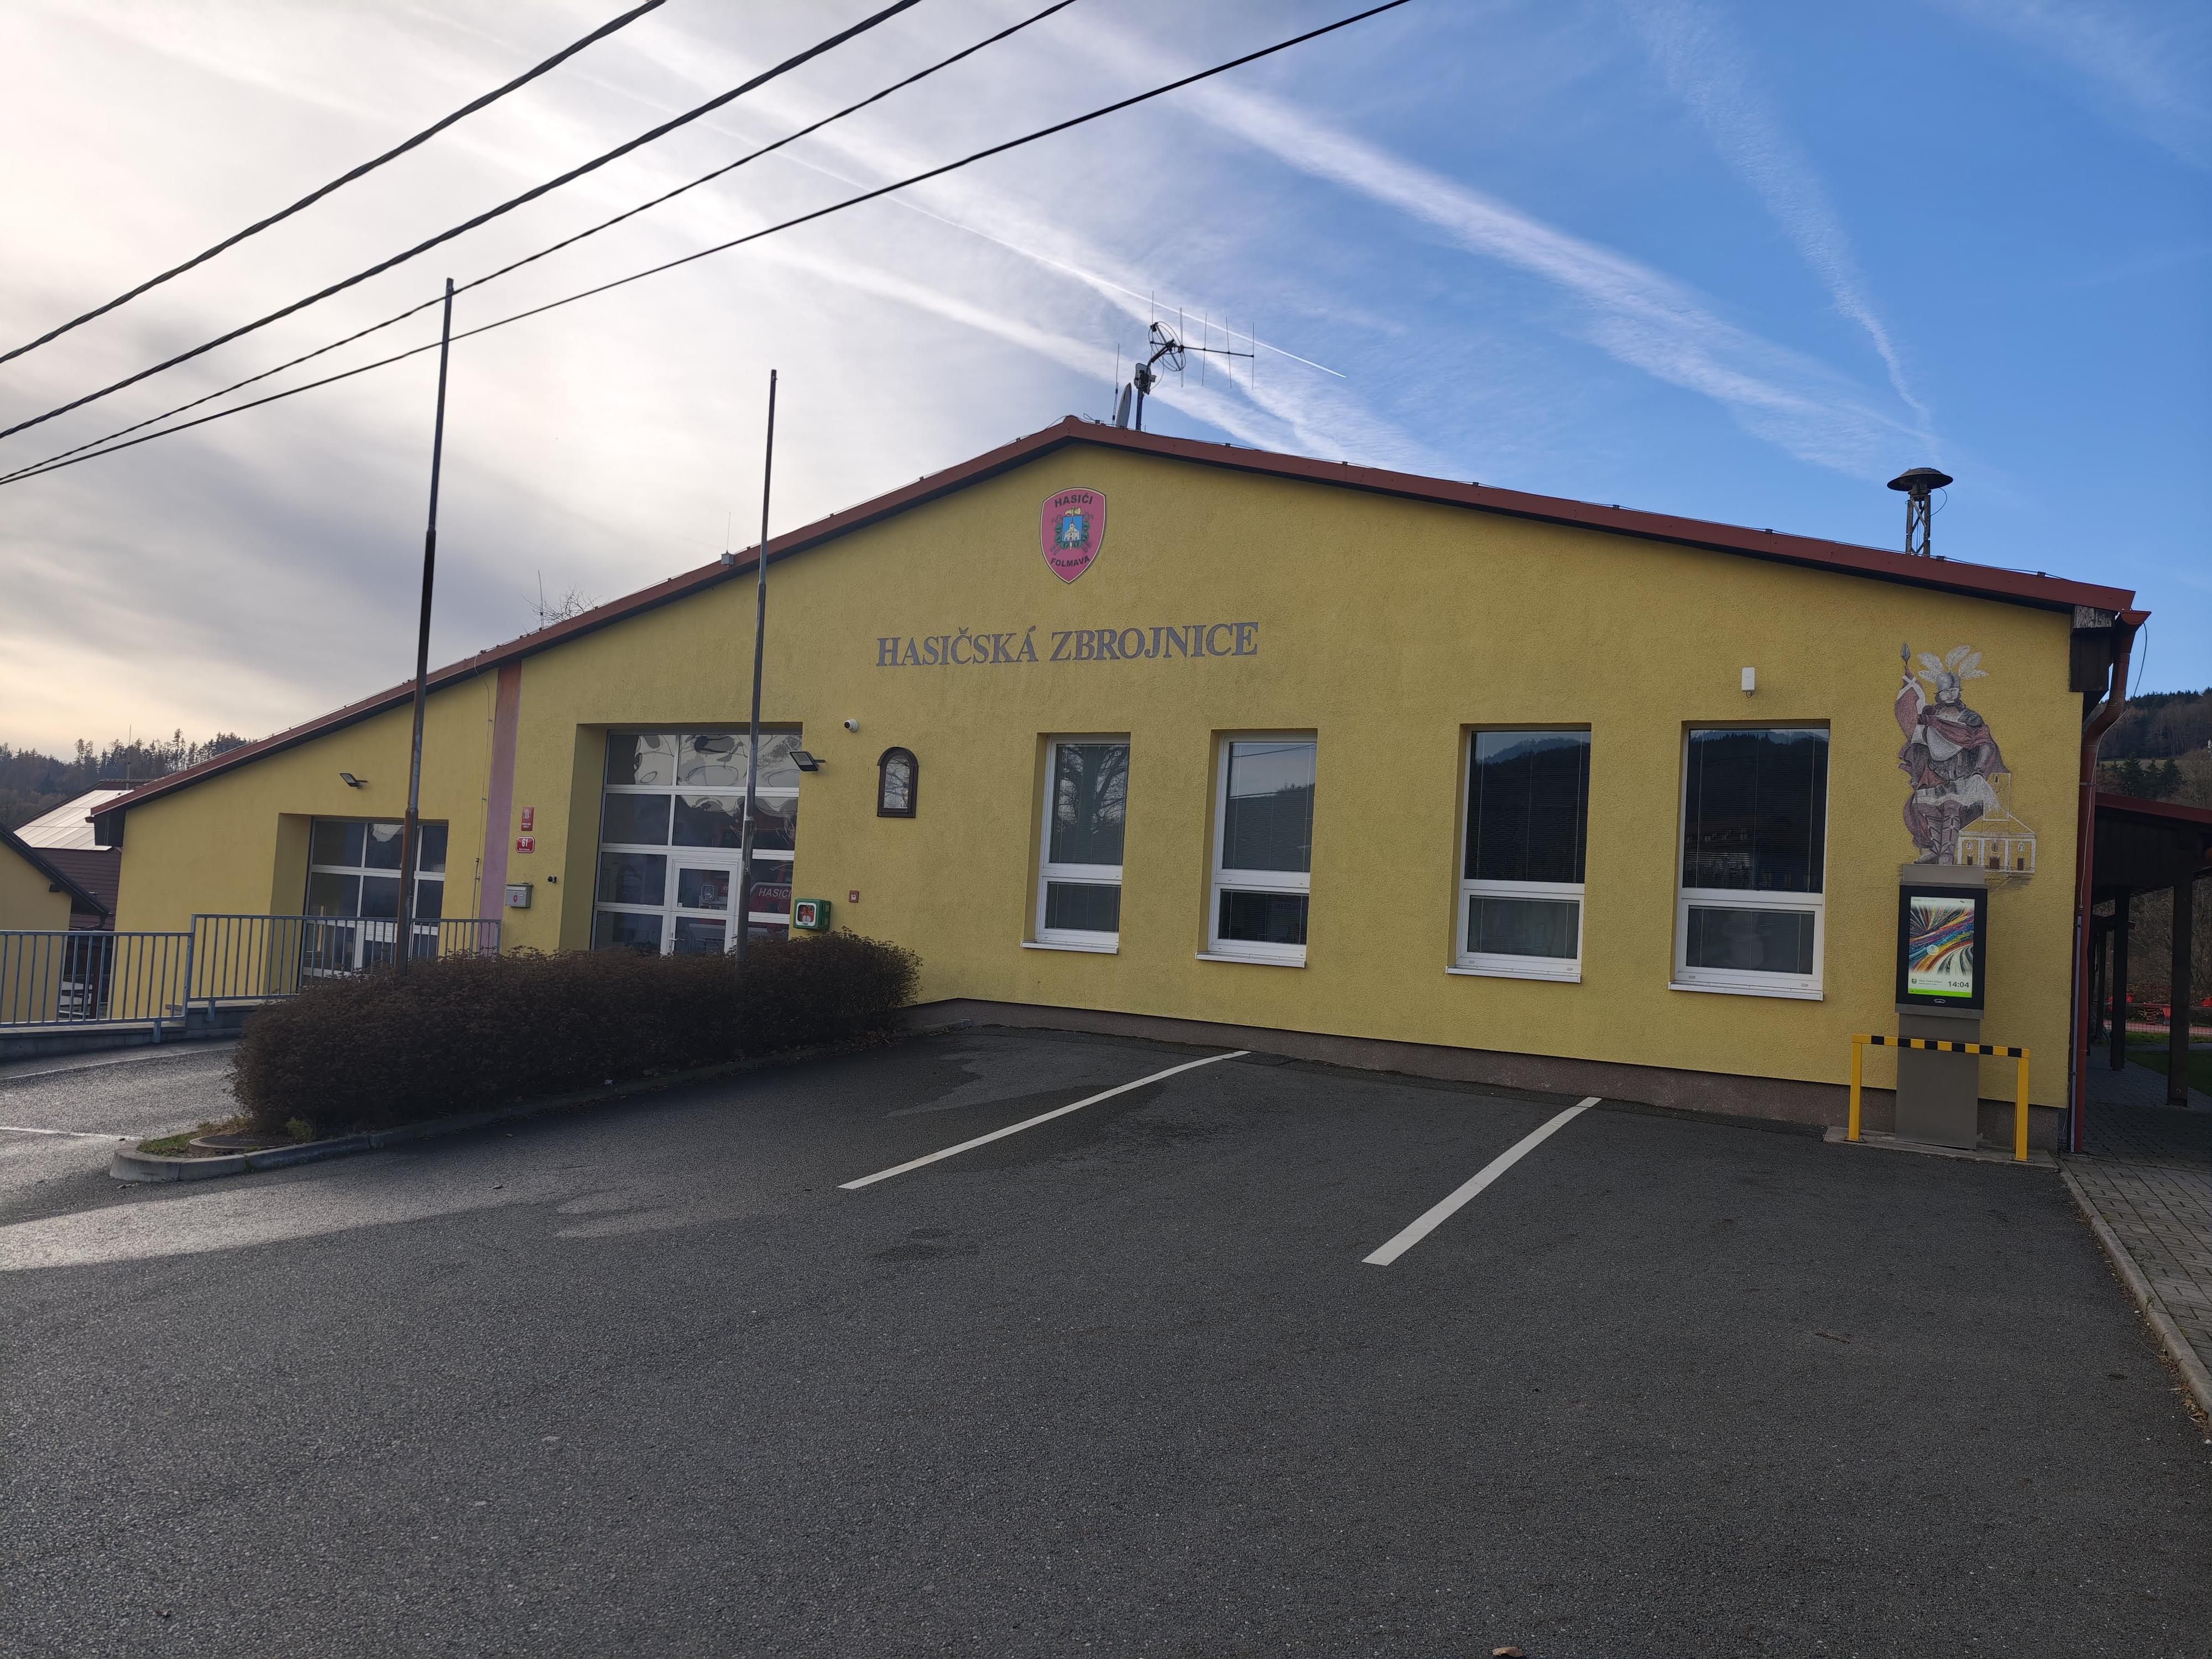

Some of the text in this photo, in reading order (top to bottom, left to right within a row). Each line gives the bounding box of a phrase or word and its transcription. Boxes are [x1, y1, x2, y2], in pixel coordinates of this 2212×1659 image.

[1055, 492, 1093, 508] HASIČI
[1051, 556, 1091, 567] FOLMAVA
[875, 622, 1259, 667] HASIČSKÁ ZBROJNICE
[522, 838, 528, 847] 61
